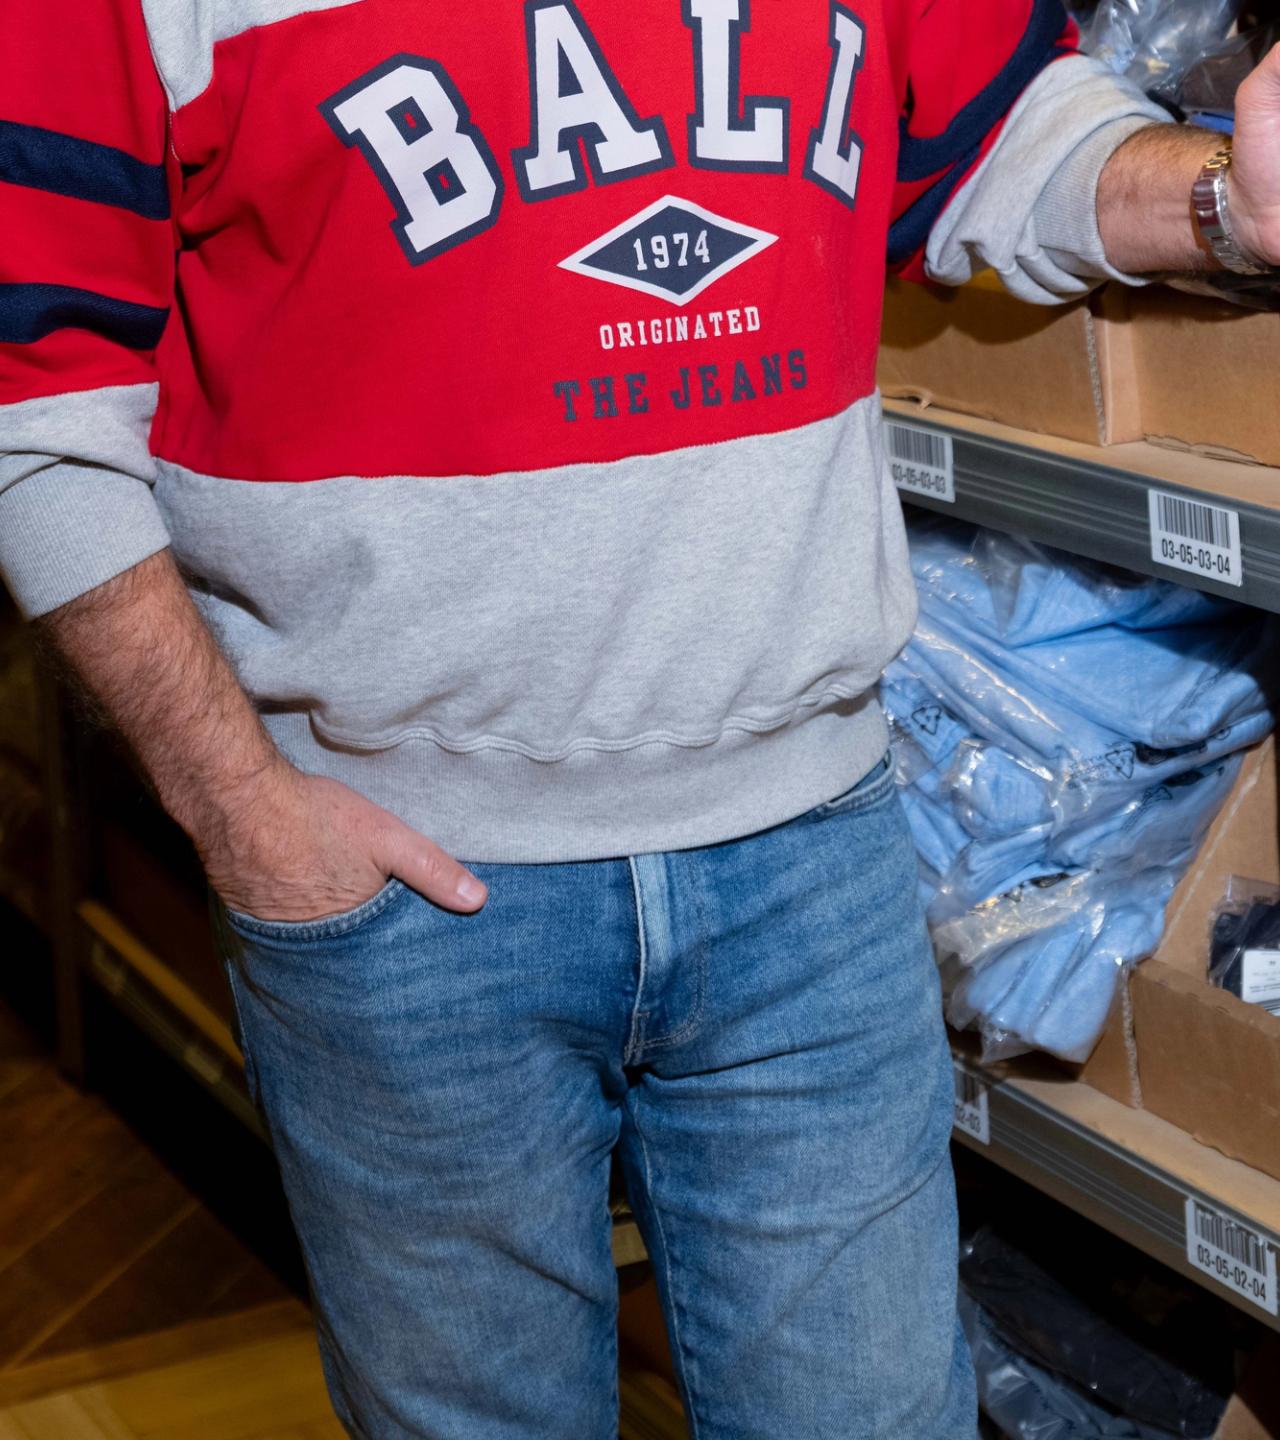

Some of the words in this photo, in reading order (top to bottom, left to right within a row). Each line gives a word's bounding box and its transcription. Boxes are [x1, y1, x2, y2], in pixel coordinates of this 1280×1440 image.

[632, 229, 711, 271] 1974
[599, 306, 761, 350] ORIGINATED
[552, 372, 651, 423] THE
[670, 349, 808, 410] JEANS
[1161, 538, 1231, 576] 03-05-03-04
[1196, 1243, 1267, 1302] 03-05-02-04
